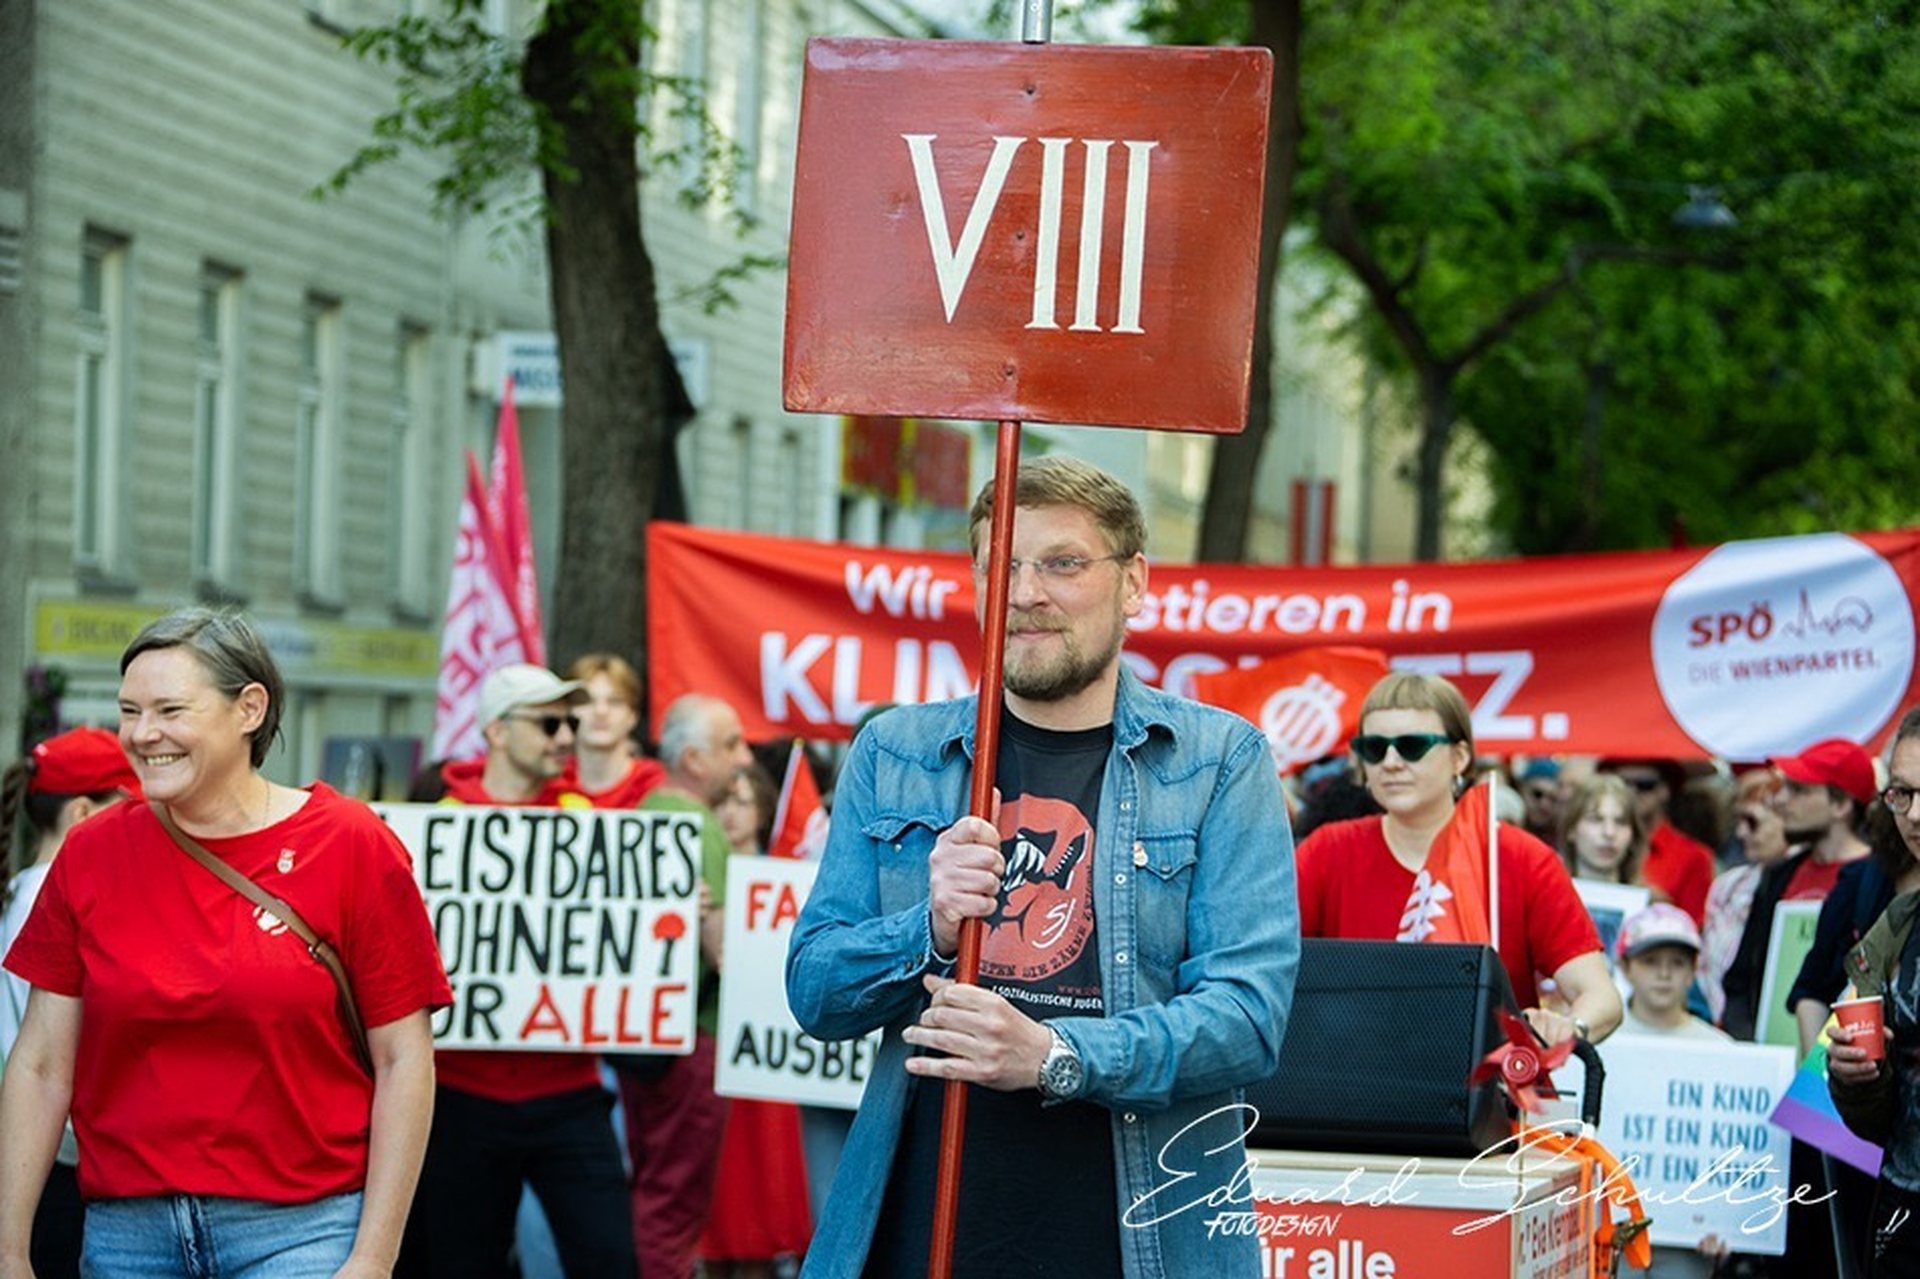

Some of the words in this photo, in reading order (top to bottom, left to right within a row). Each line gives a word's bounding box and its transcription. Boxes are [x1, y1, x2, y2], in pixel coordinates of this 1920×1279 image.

[901, 134, 1159, 333] VIII
[845, 561, 960, 621] Wir
[1387, 579, 1453, 632] in
[1687, 600, 1773, 649] SPÖ
[1688, 663, 1722, 683] DIE
[380, 813, 699, 899] EISTBARES
[426, 900, 638, 978] OHNEN
[520, 982, 687, 1045] ALLE
[1667, 1080, 1702, 1108] EIN
[1713, 1083, 1770, 1114] KIND
[1623, 1114, 1655, 1141] IST
[1665, 1117, 1700, 1146] EIN
[1711, 1121, 1768, 1152] KIND
[1664, 1154, 1698, 1183] EIN
